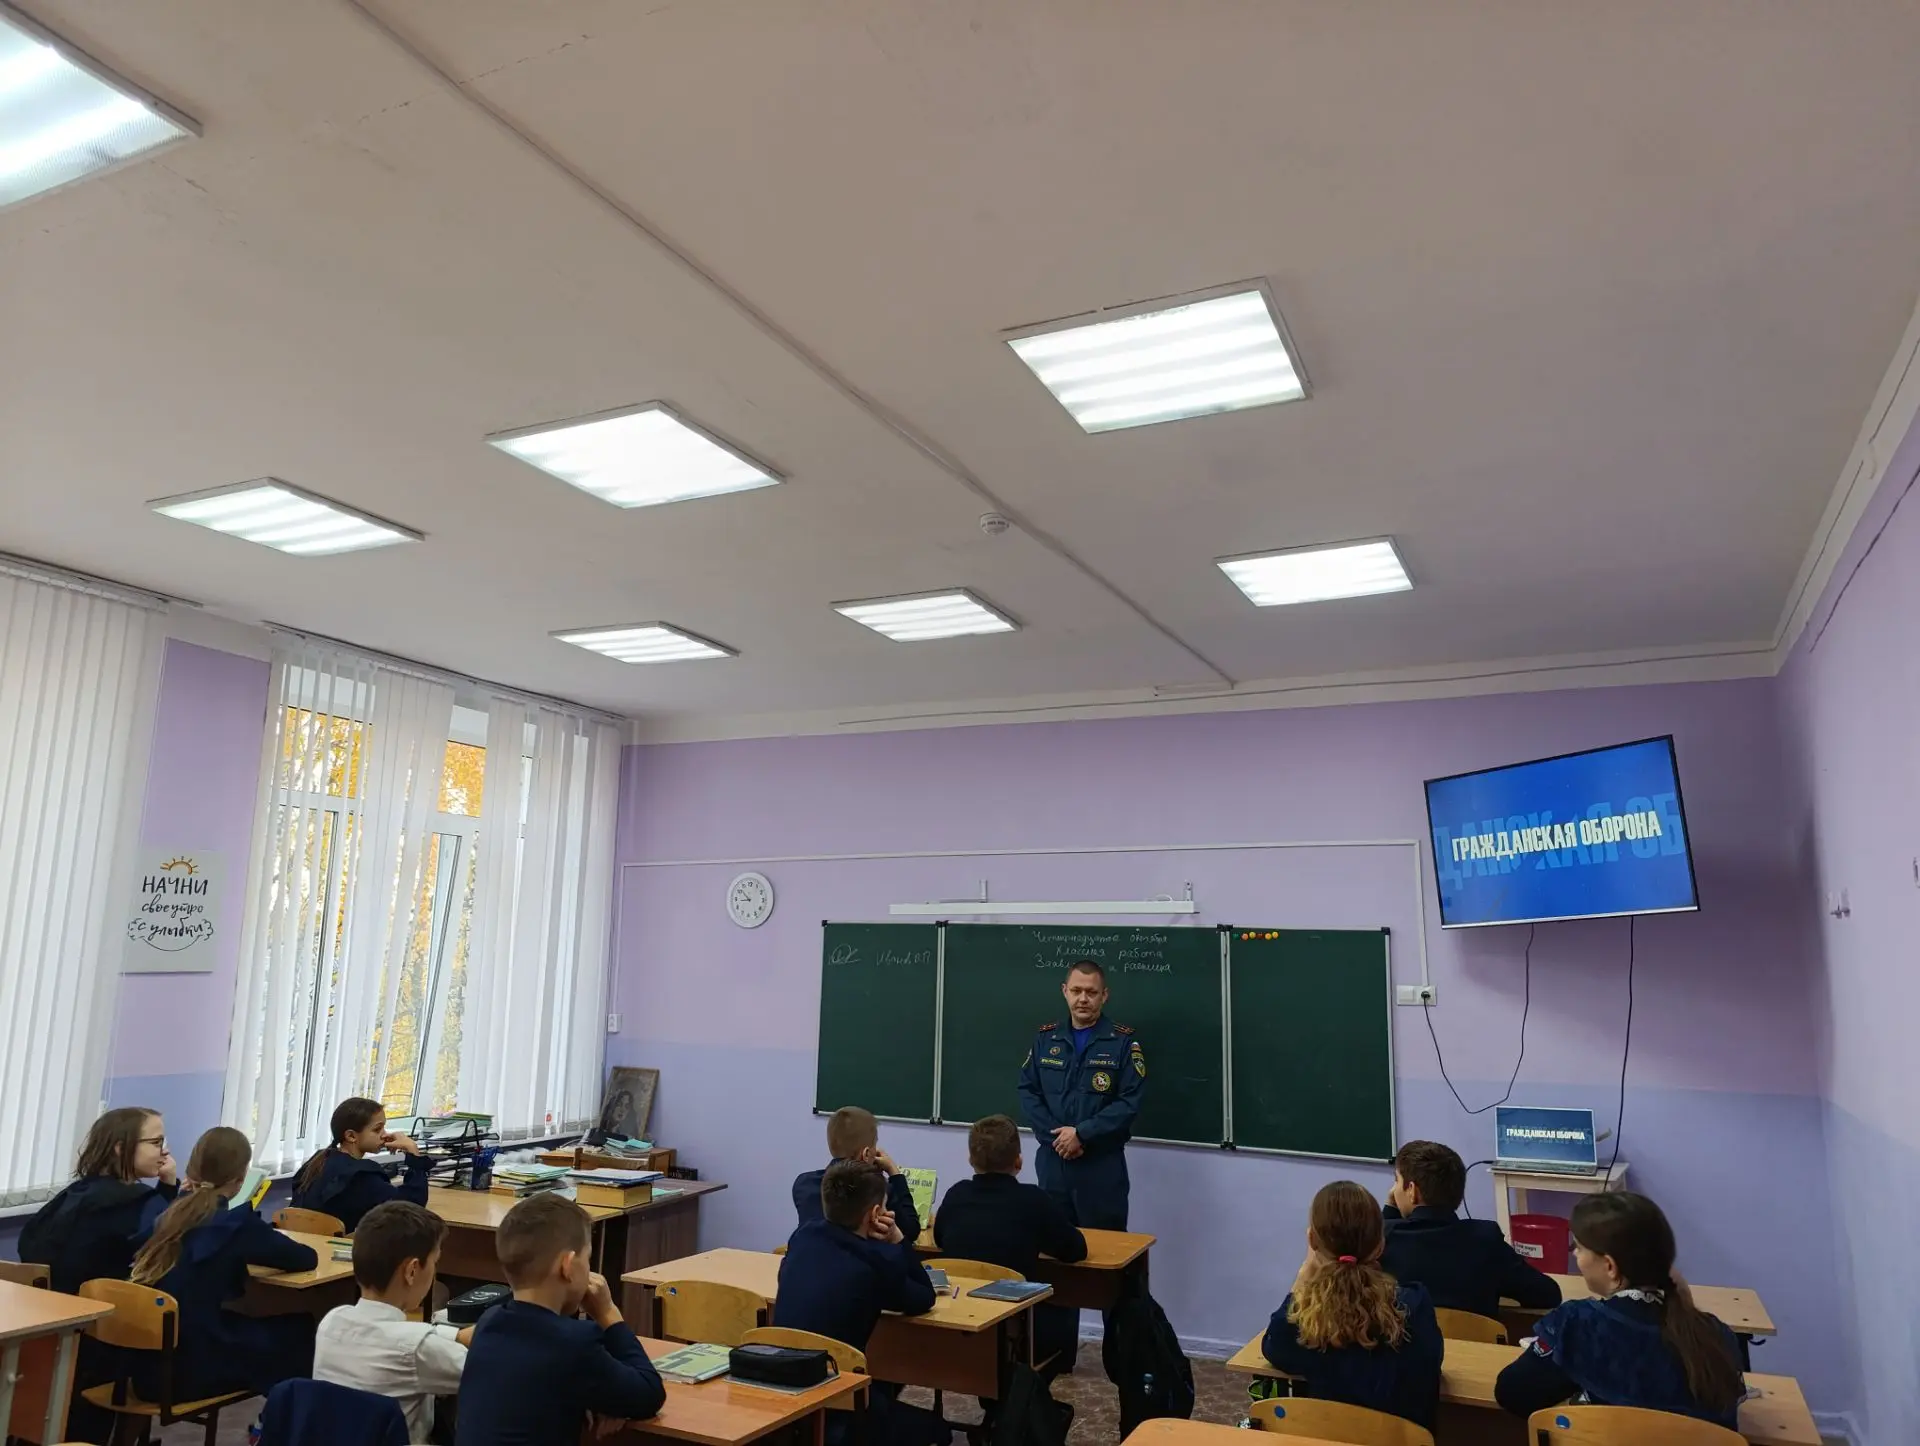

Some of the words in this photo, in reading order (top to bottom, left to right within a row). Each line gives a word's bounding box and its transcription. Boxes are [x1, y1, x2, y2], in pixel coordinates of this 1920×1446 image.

[1452, 822, 1577, 862] ГРАЖДАНСКАЯ
[1580, 811, 1662, 846] ОБОРОНА
[142, 875, 208, 895] НАЧНИ
[141, 893, 169, 913] свое
[171, 903, 204, 918] утро
[147, 917, 203, 941] улыбки
[1118, 948, 1163, 960] работа
[1506, 1128, 1556, 1139] ГРАЖДАНСКАЯ
[1556, 1131, 1585, 1140] ОБОРОНА
